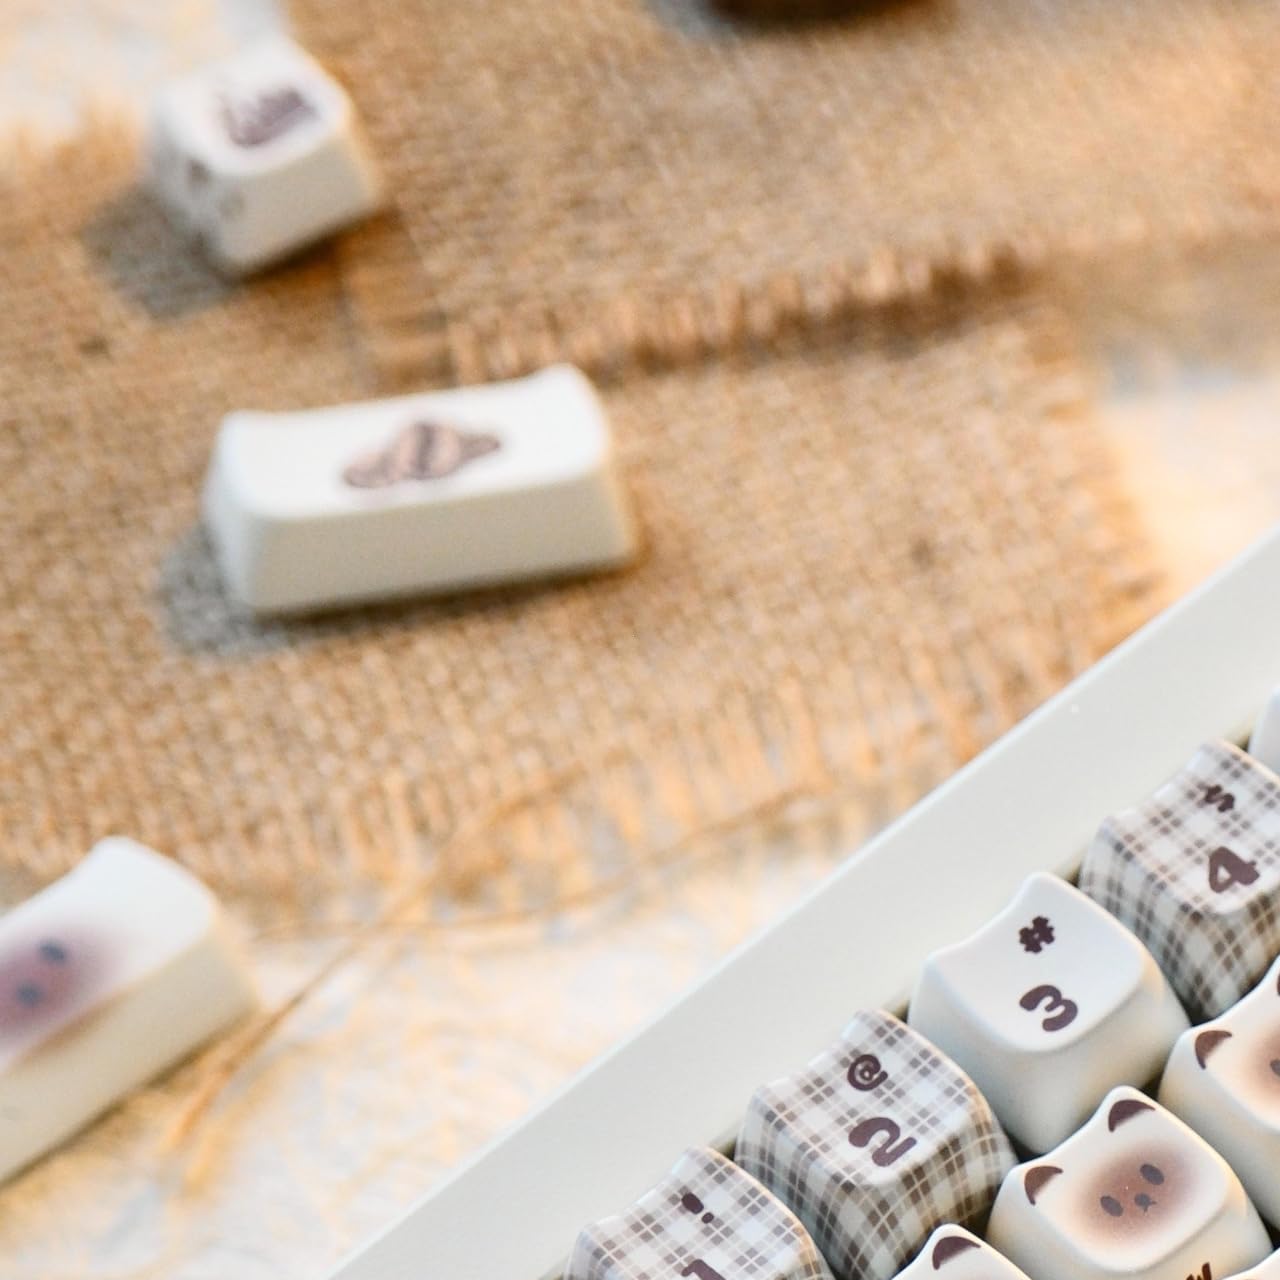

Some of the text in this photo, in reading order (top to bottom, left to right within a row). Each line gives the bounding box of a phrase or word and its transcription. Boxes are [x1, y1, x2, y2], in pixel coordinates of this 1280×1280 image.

[1208, 846, 1260, 893] 4
[1019, 984, 1078, 1032] 3
[848, 1117, 917, 1167] 2
